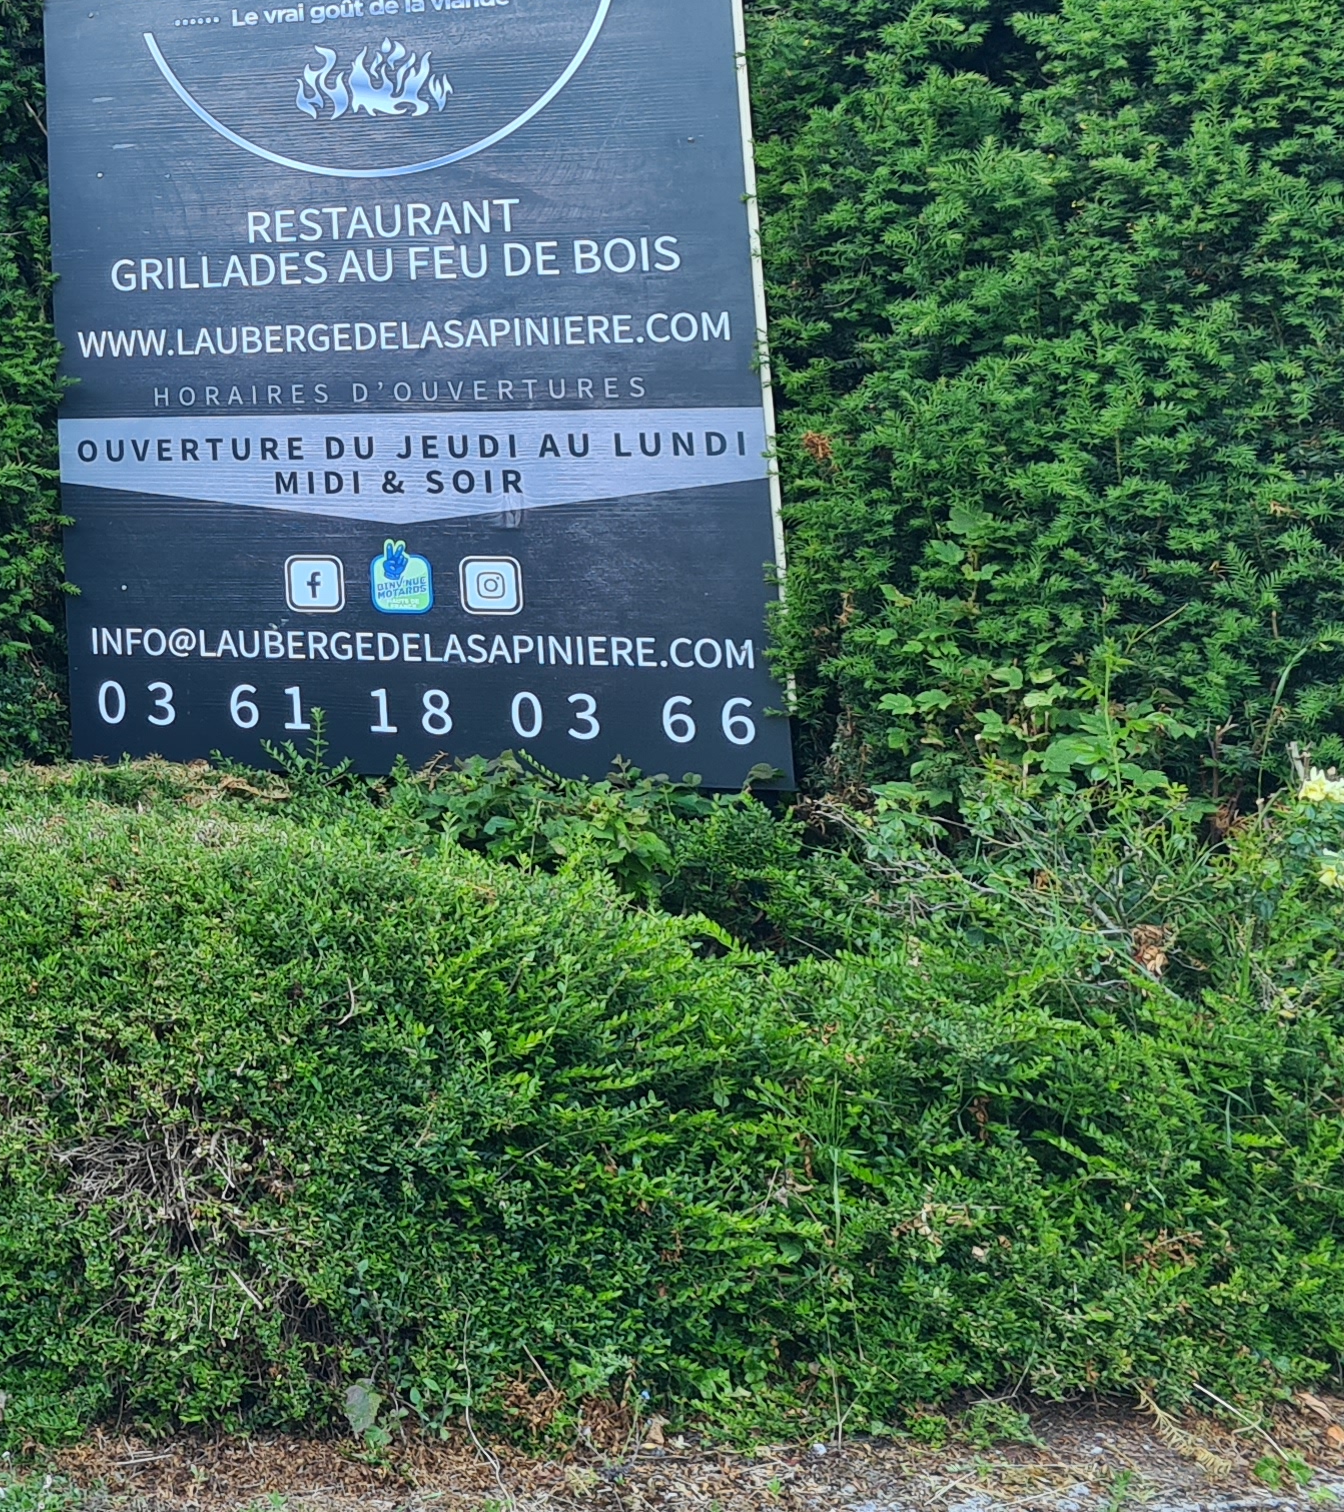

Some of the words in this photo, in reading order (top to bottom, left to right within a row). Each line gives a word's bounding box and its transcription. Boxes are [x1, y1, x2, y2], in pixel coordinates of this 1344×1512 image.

[232, 8, 258, 27] Le
[263, 2, 304, 24] vrai
[311, 0, 364, 25] goût
[247, 198, 520, 244] RESTAURANT
[111, 251, 328, 291] GRILLADES
[338, 248, 395, 283] AU
[410, 244, 489, 280] FEU
[503, 240, 561, 277] DE
[574, 235, 682, 274] BOIS
[77, 310, 732, 359] WWW.LAUBERGEDELASAPINIERE.COM
[153, 383, 330, 408] HORAIRES
[352, 376, 648, 403] D'OUVERTURES
[77, 436, 305, 464] OUVERTURE
[326, 435, 375, 461] DU
[396, 433, 518, 461] JEUDI
[539, 432, 591, 458] AU
[614, 430, 747, 457] LUNDI
[275, 471, 362, 495] MIDI
[381, 470, 406, 494] &
[426, 469, 525, 494] SOIR
[91, 626, 756, 670] INFO@LAUBERGEDELASAPINIERE.COM
[98, 680, 177, 727] 03
[230, 683, 311, 730] 61
[370, 687, 453, 735] 18
[511, 690, 601, 740] 03
[662, 694, 757, 746] 66
